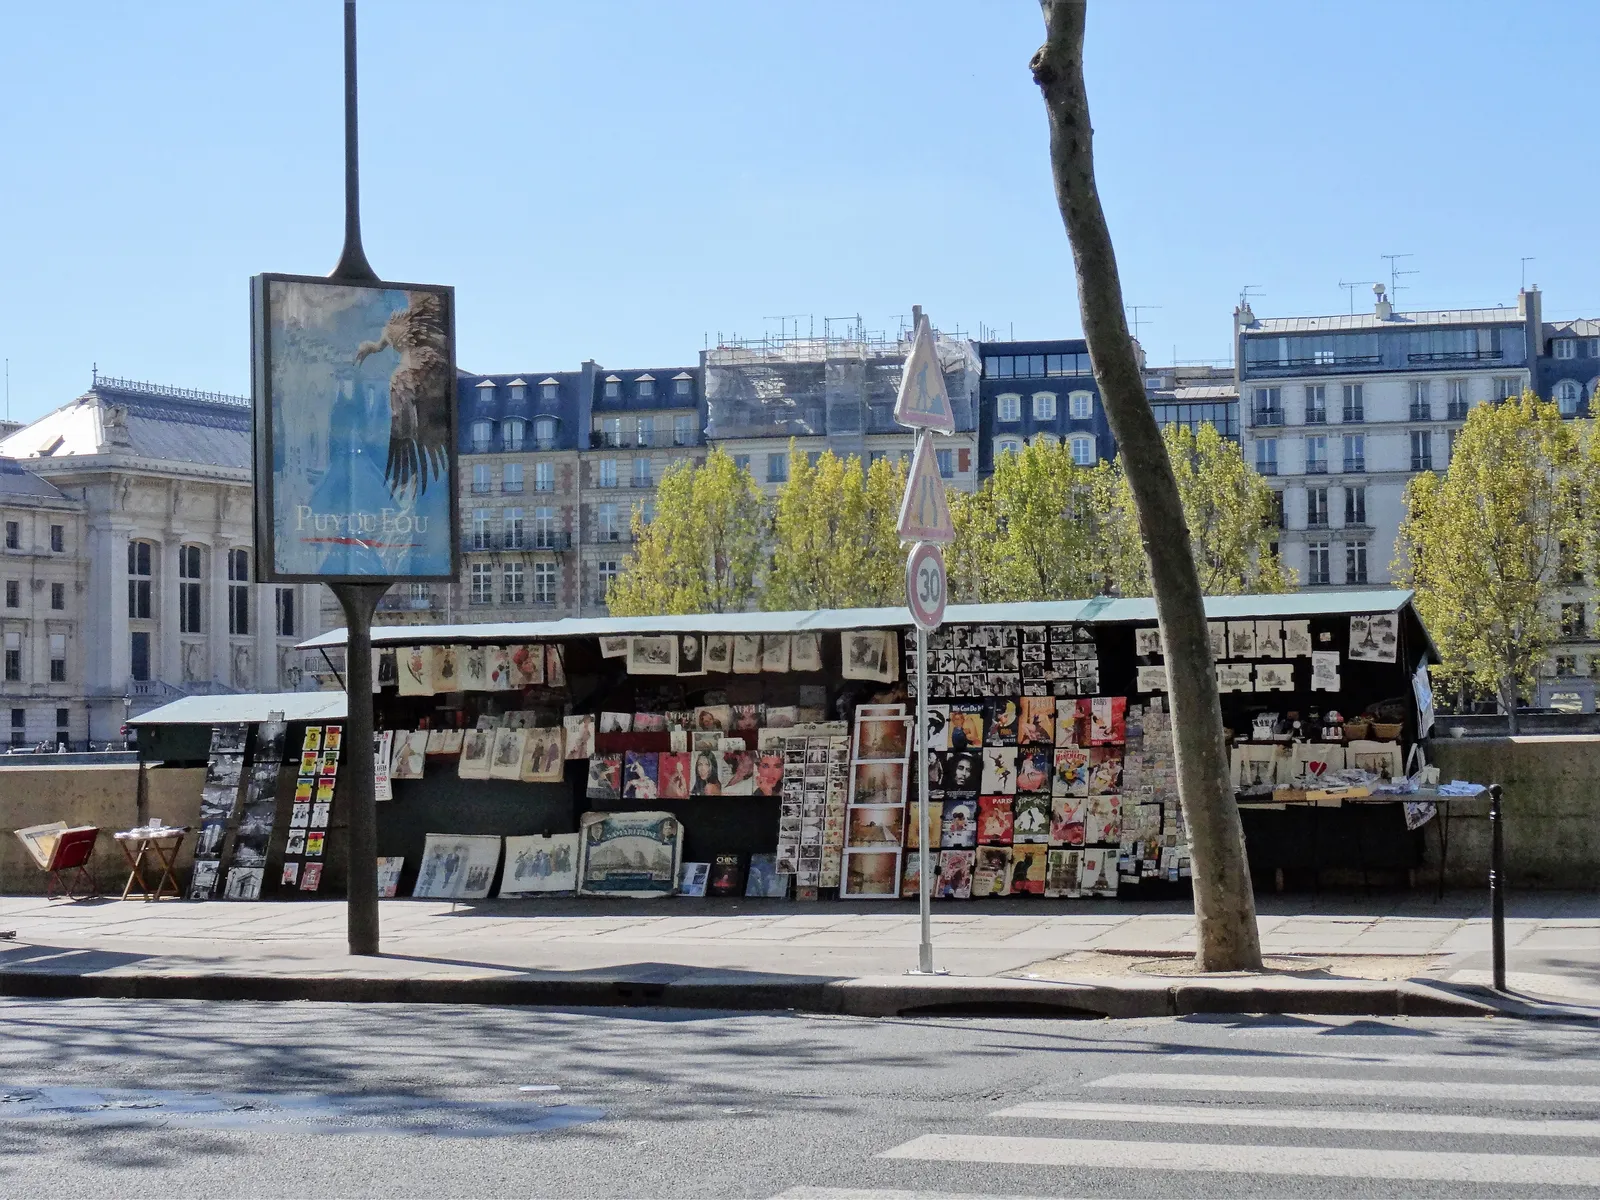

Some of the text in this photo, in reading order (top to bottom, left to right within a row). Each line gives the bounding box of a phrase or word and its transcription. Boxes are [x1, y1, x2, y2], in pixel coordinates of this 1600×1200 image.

[294, 505, 344, 531] PUY
[348, 511, 378, 533] DU
[919, 568, 940, 603] 30
[1020, 746, 1041, 755] PARIS
[1299, 760, 1309, 776] I
[992, 798, 1013, 806] PARIS
